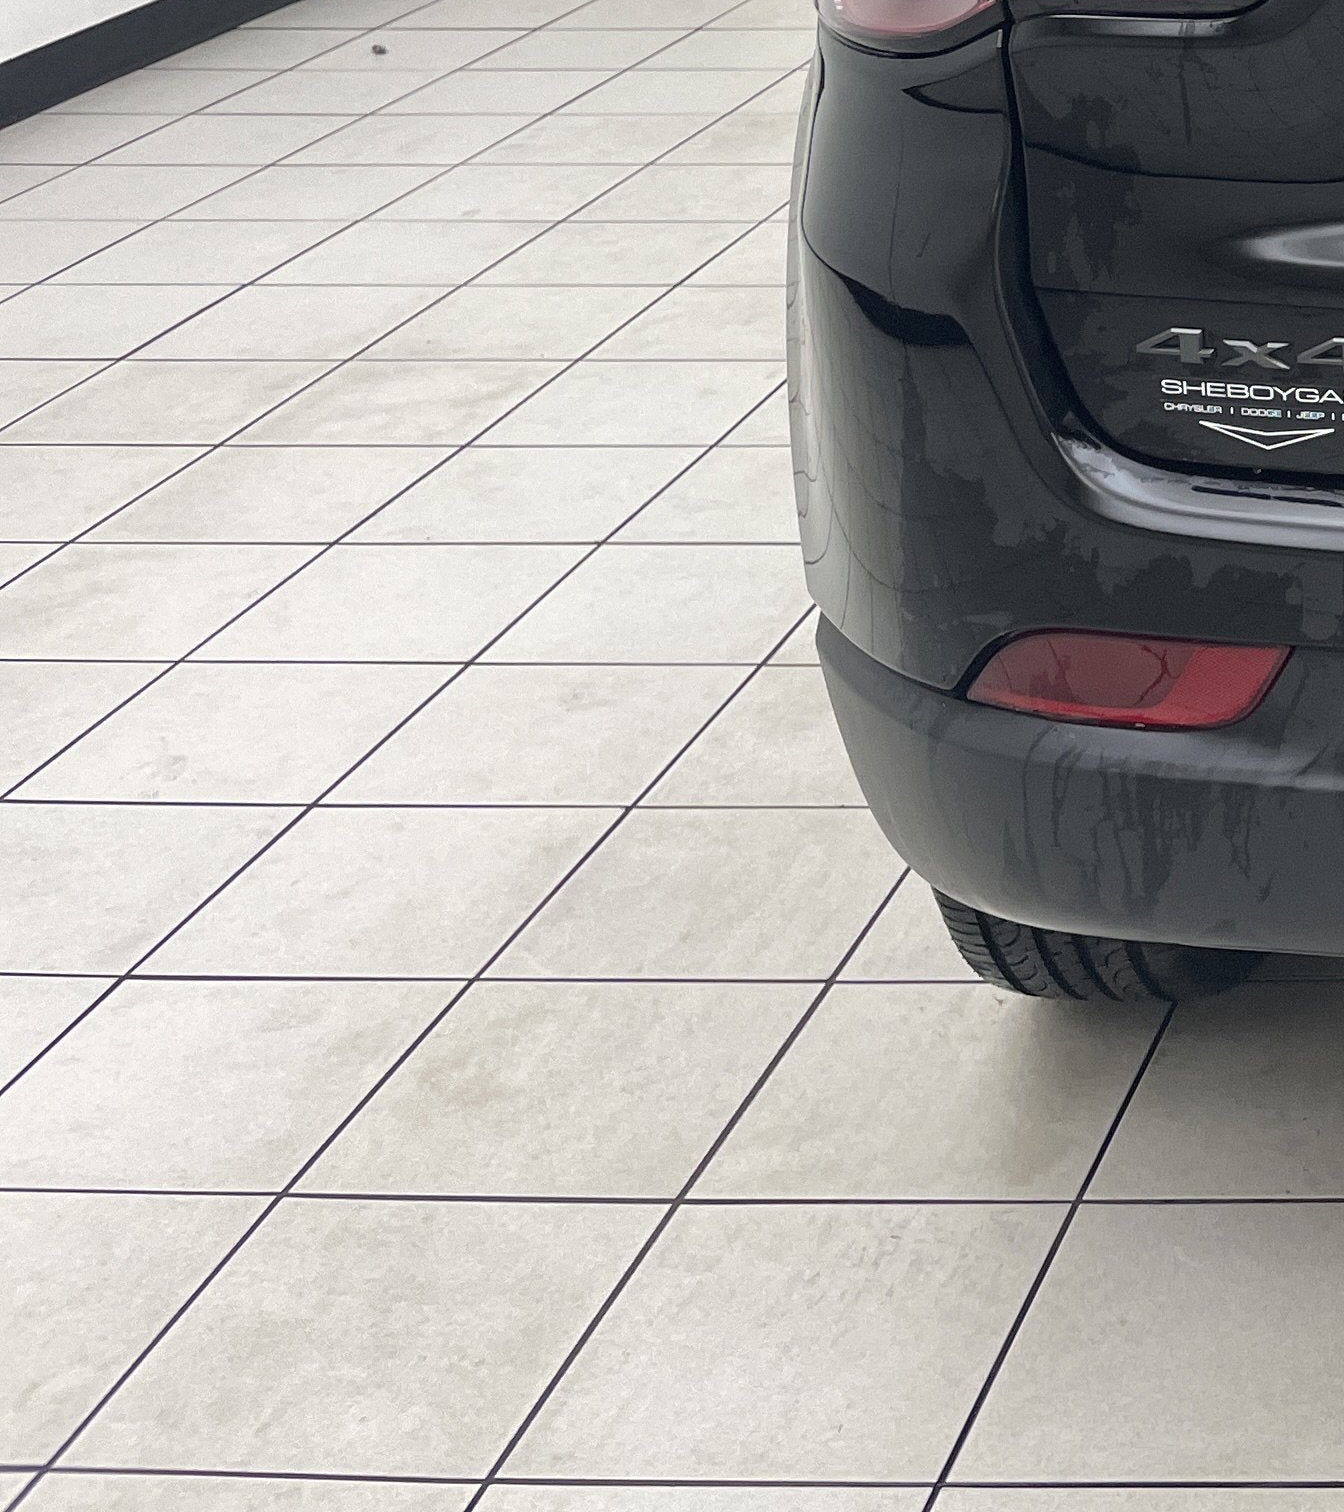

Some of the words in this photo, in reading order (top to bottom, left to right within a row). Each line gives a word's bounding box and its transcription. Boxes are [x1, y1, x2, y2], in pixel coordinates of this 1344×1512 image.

[1164, 402, 1223, 414] CHRYSLER
[1241, 407, 1282, 418] DODGE
[1296, 411, 1325, 419] JEEP
